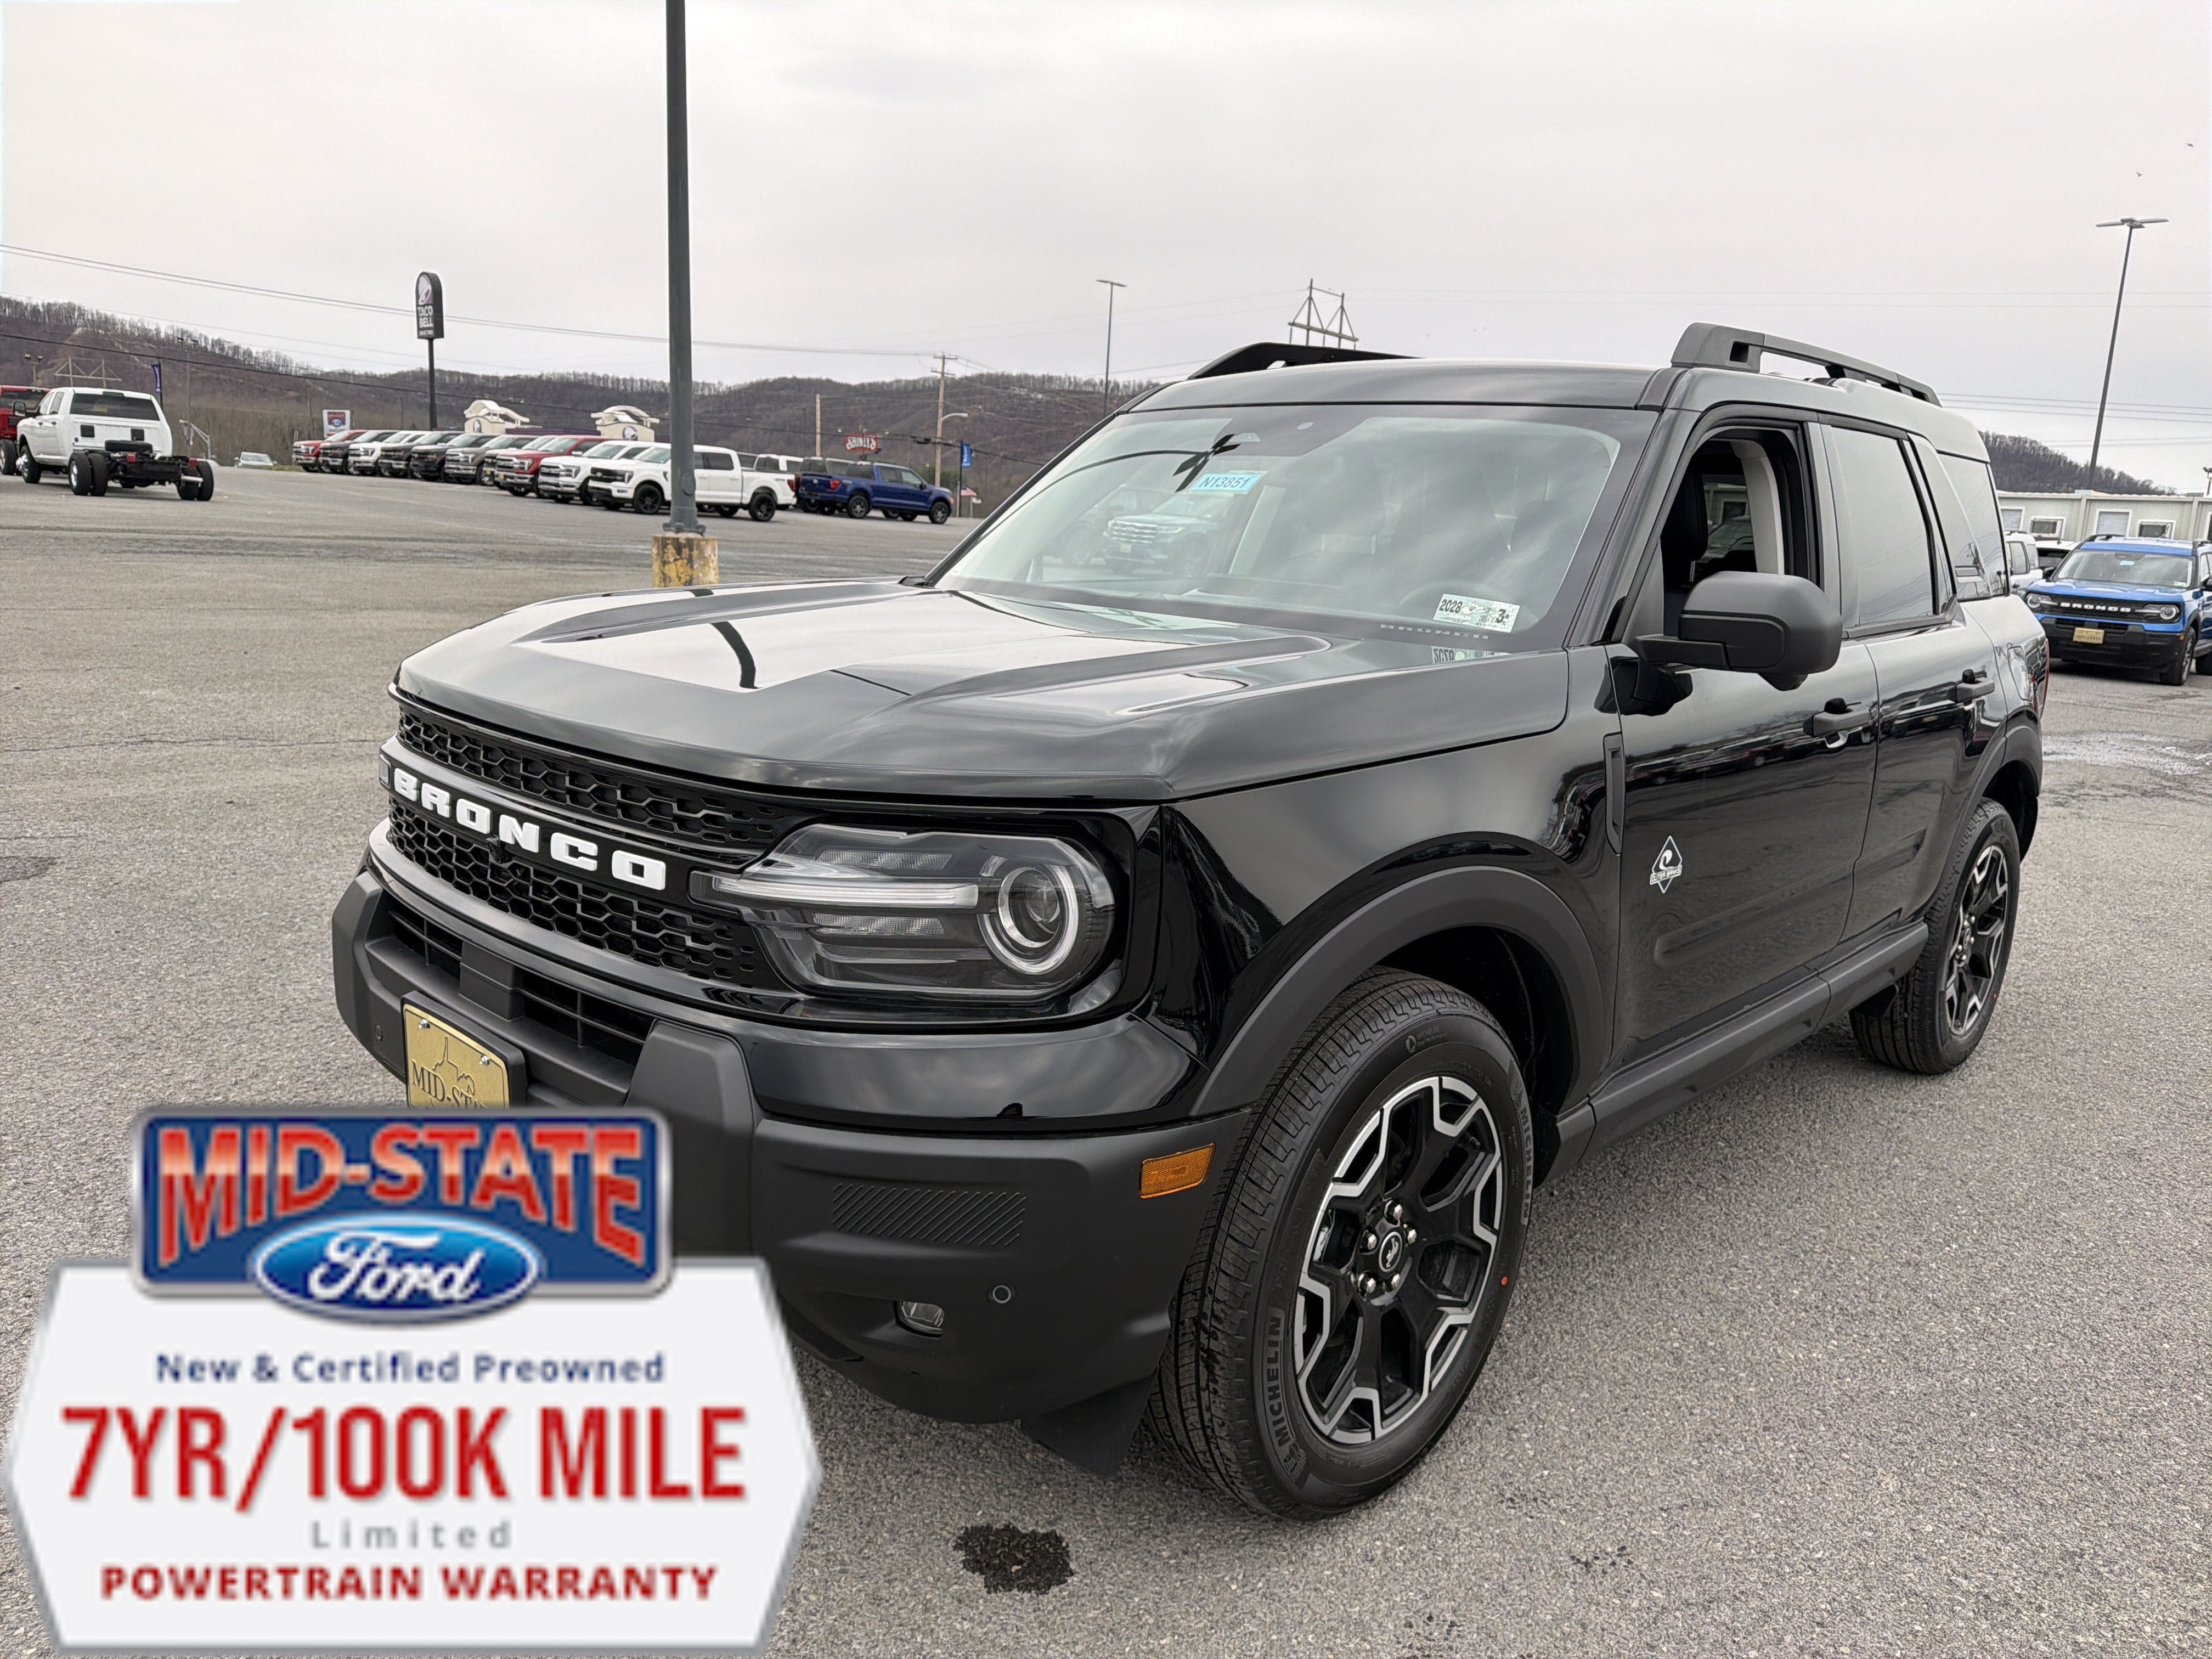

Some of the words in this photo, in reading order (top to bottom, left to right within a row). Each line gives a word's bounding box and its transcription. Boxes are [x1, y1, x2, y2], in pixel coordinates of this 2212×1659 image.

[417, 305, 433, 316] TACO
[419, 317, 434, 328] BELL
[1198, 476, 1251, 489] N13851
[1438, 599, 1463, 614] 2028
[2060, 602, 2131, 612] BRONCO
[393, 768, 666, 891] BRONCO
[1651, 872, 1666, 882] OUTER
[1666, 867, 1681, 877] BANKS
[1519, 1105, 1532, 1219] MICHELIN
[1266, 1316, 1291, 1447] MICHELIN
